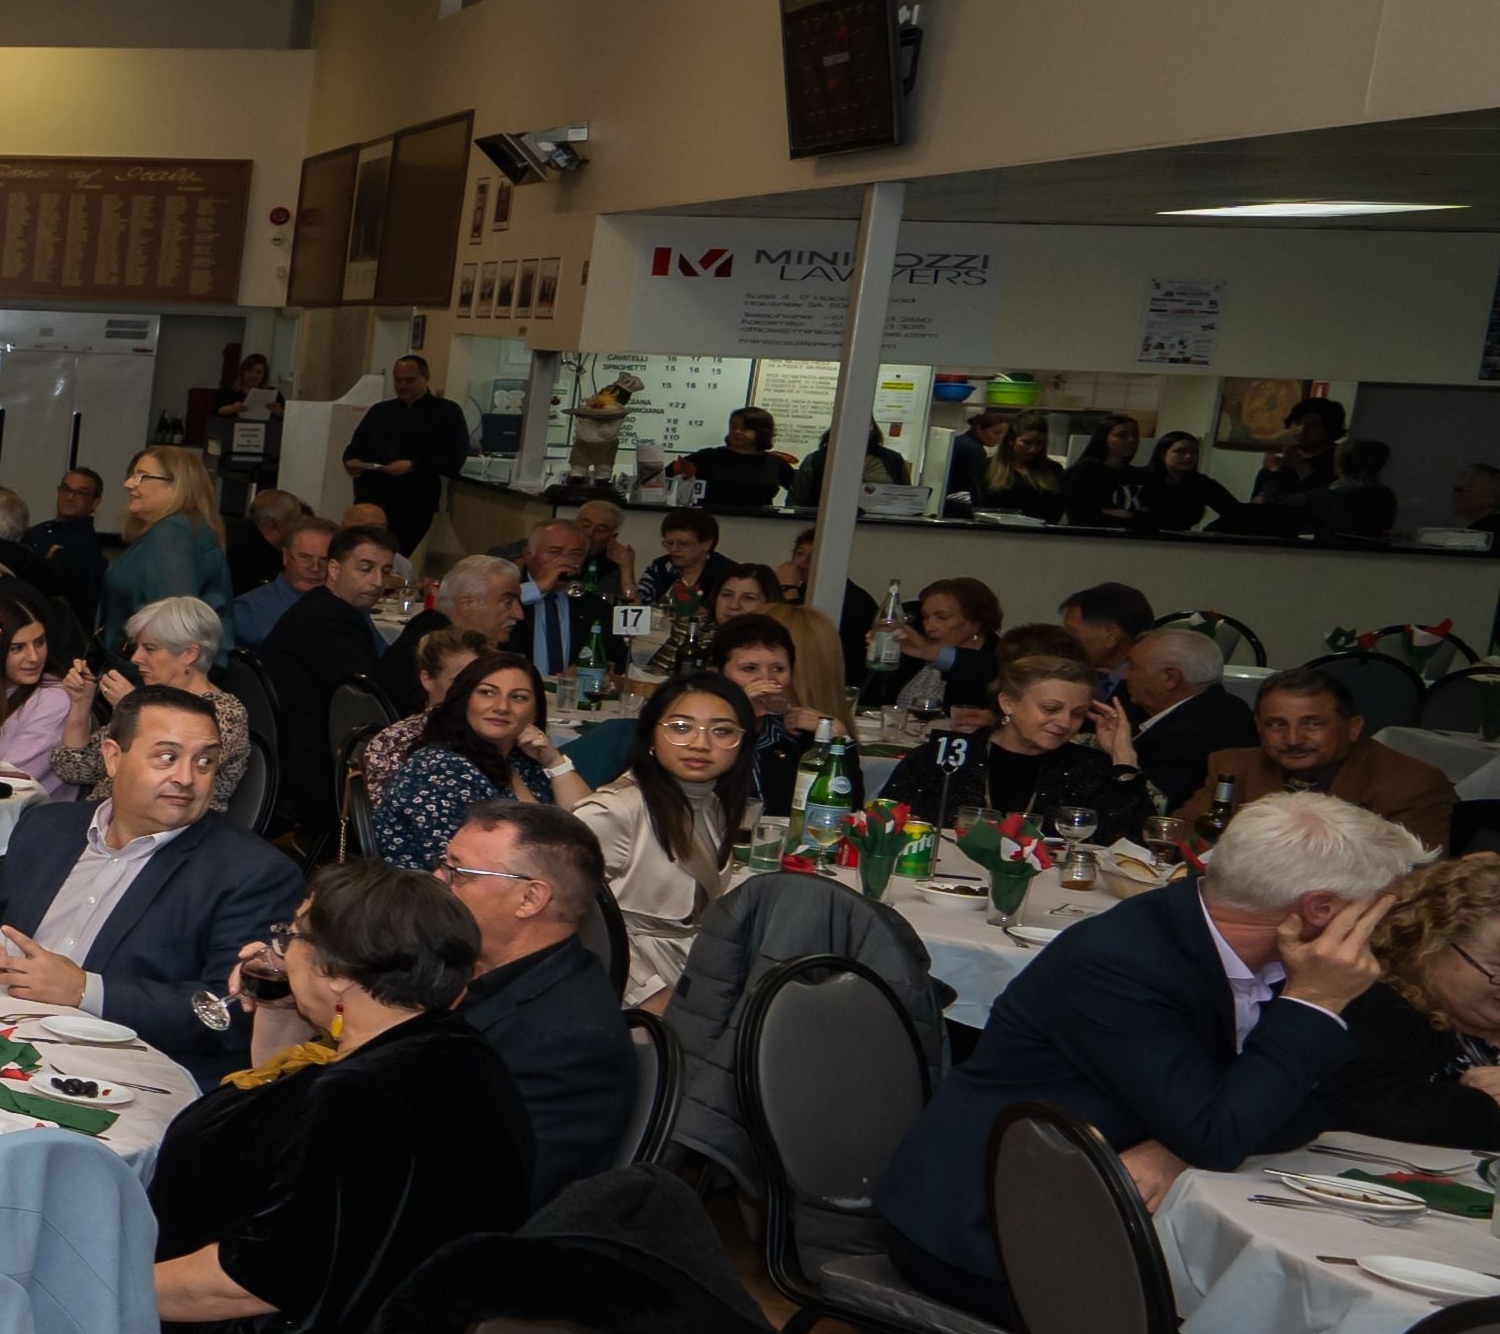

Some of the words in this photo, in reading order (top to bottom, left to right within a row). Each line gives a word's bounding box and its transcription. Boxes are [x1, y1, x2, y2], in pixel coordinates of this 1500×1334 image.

[67, 168, 102, 187] of
[755, 250, 989, 270] MINIOZZI
[694, 482, 703, 494] 9
[620, 609, 643, 627] 17
[936, 736, 968, 767] 13
